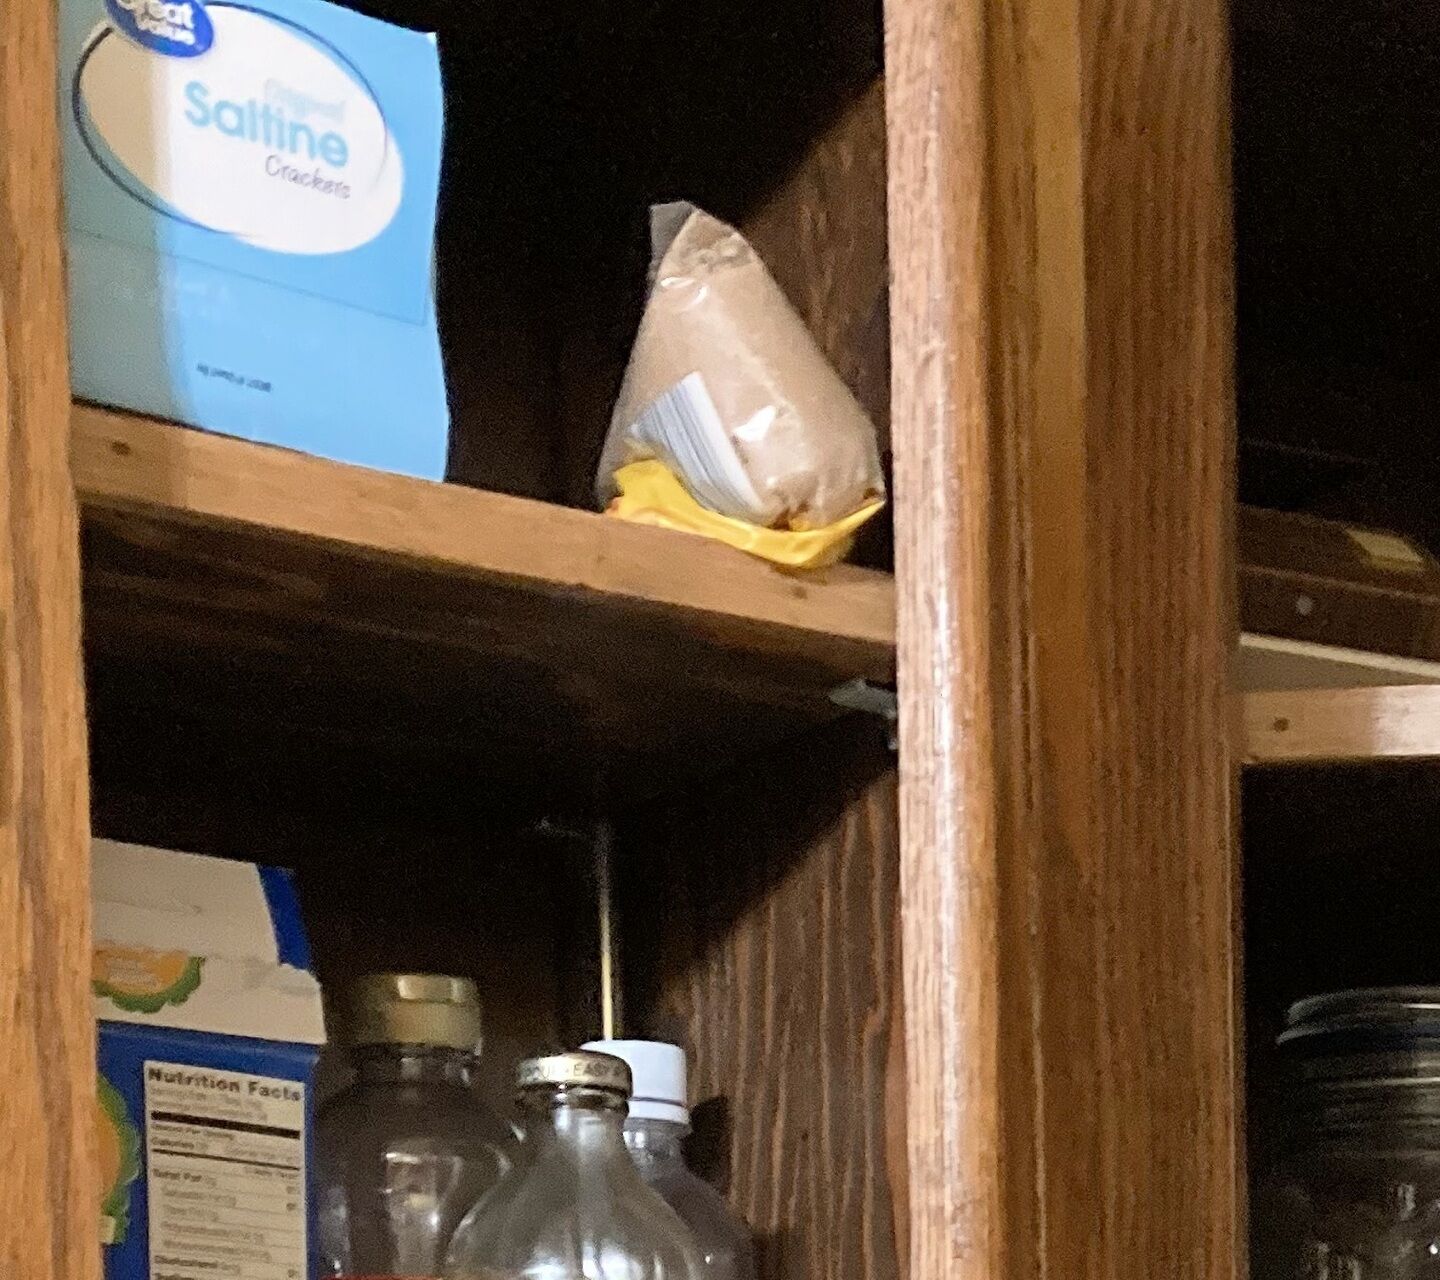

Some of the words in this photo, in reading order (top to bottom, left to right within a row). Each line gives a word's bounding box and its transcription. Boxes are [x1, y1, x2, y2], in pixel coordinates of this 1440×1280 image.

[184, 80, 348, 168] Saltine
[265, 154, 351, 200] Crackers
[149, 1067, 241, 1093] Nutrition
[247, 1081, 301, 1101] Facts
